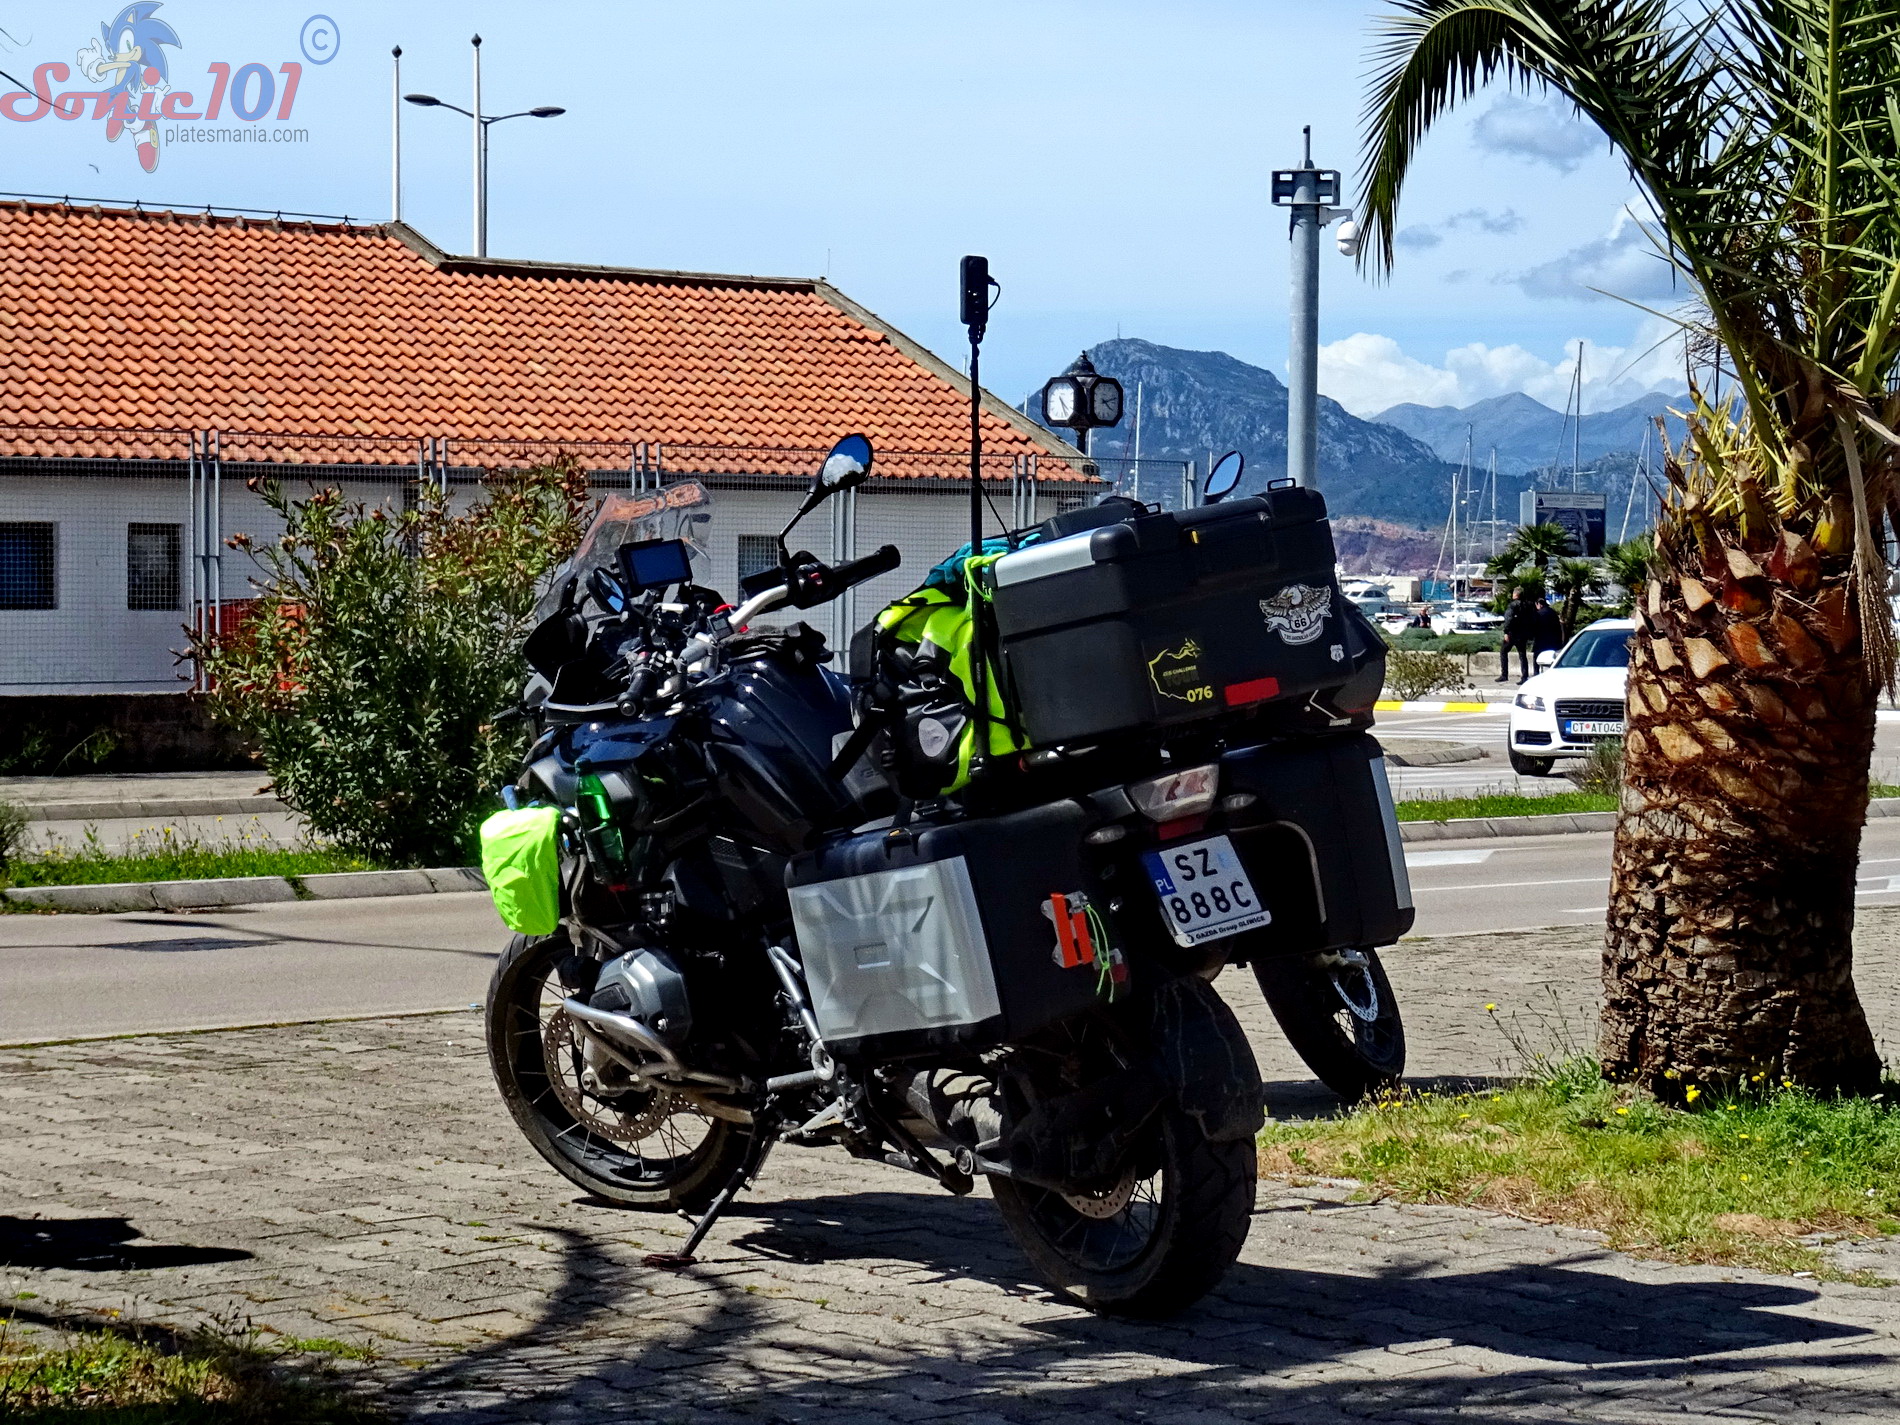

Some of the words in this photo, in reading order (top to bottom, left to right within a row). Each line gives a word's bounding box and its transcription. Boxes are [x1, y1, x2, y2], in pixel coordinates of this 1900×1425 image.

[1294, 618, 1307, 628] 66
[1187, 686, 1213, 703] 076
[1572, 722, 1584, 732] CT
[1591, 722, 1622, 733] AT045
[1175, 848, 1218, 882] SZ
[1154, 878, 1174, 893] PL
[1171, 880, 1252, 924] 888C
[1195, 930, 1218, 940] GAZDA
[1218, 921, 1238, 934] Group
[1238, 915, 1266, 927] GLIWICE
